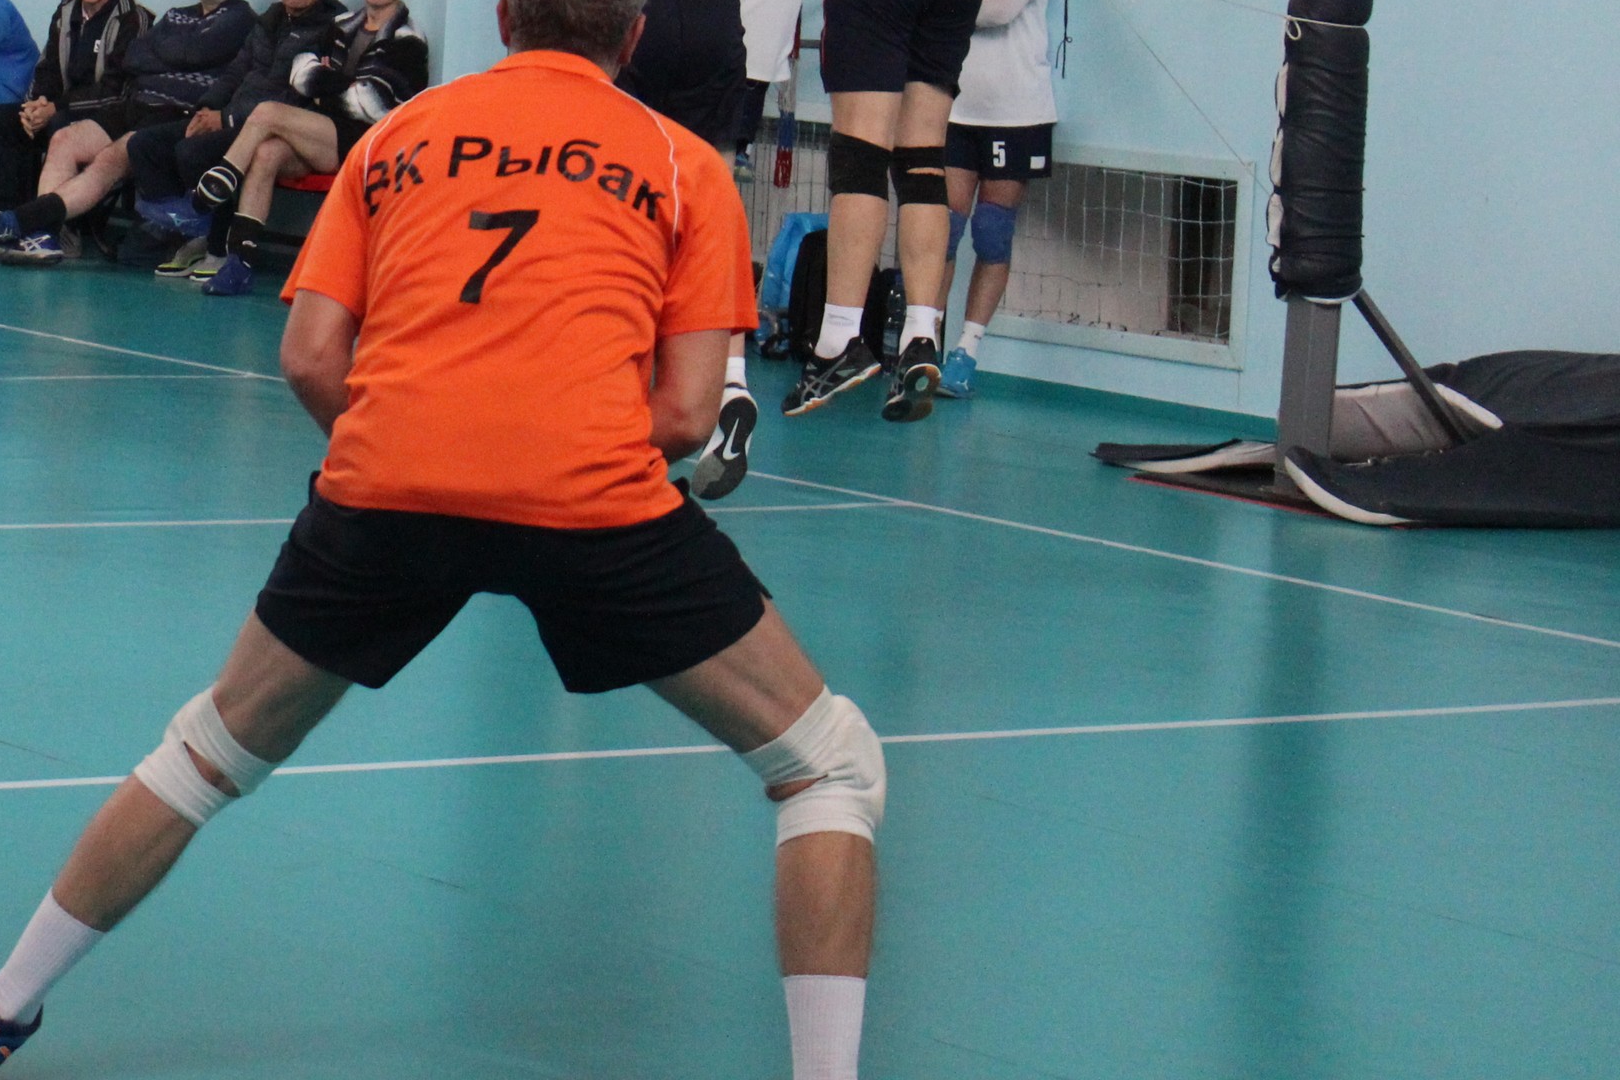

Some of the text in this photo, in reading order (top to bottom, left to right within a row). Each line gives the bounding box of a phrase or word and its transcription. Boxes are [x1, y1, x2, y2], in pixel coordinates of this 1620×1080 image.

[363, 135, 667, 221] ВК Рыбак
[992, 141, 1006, 168] 5
[458, 209, 540, 304] 7
